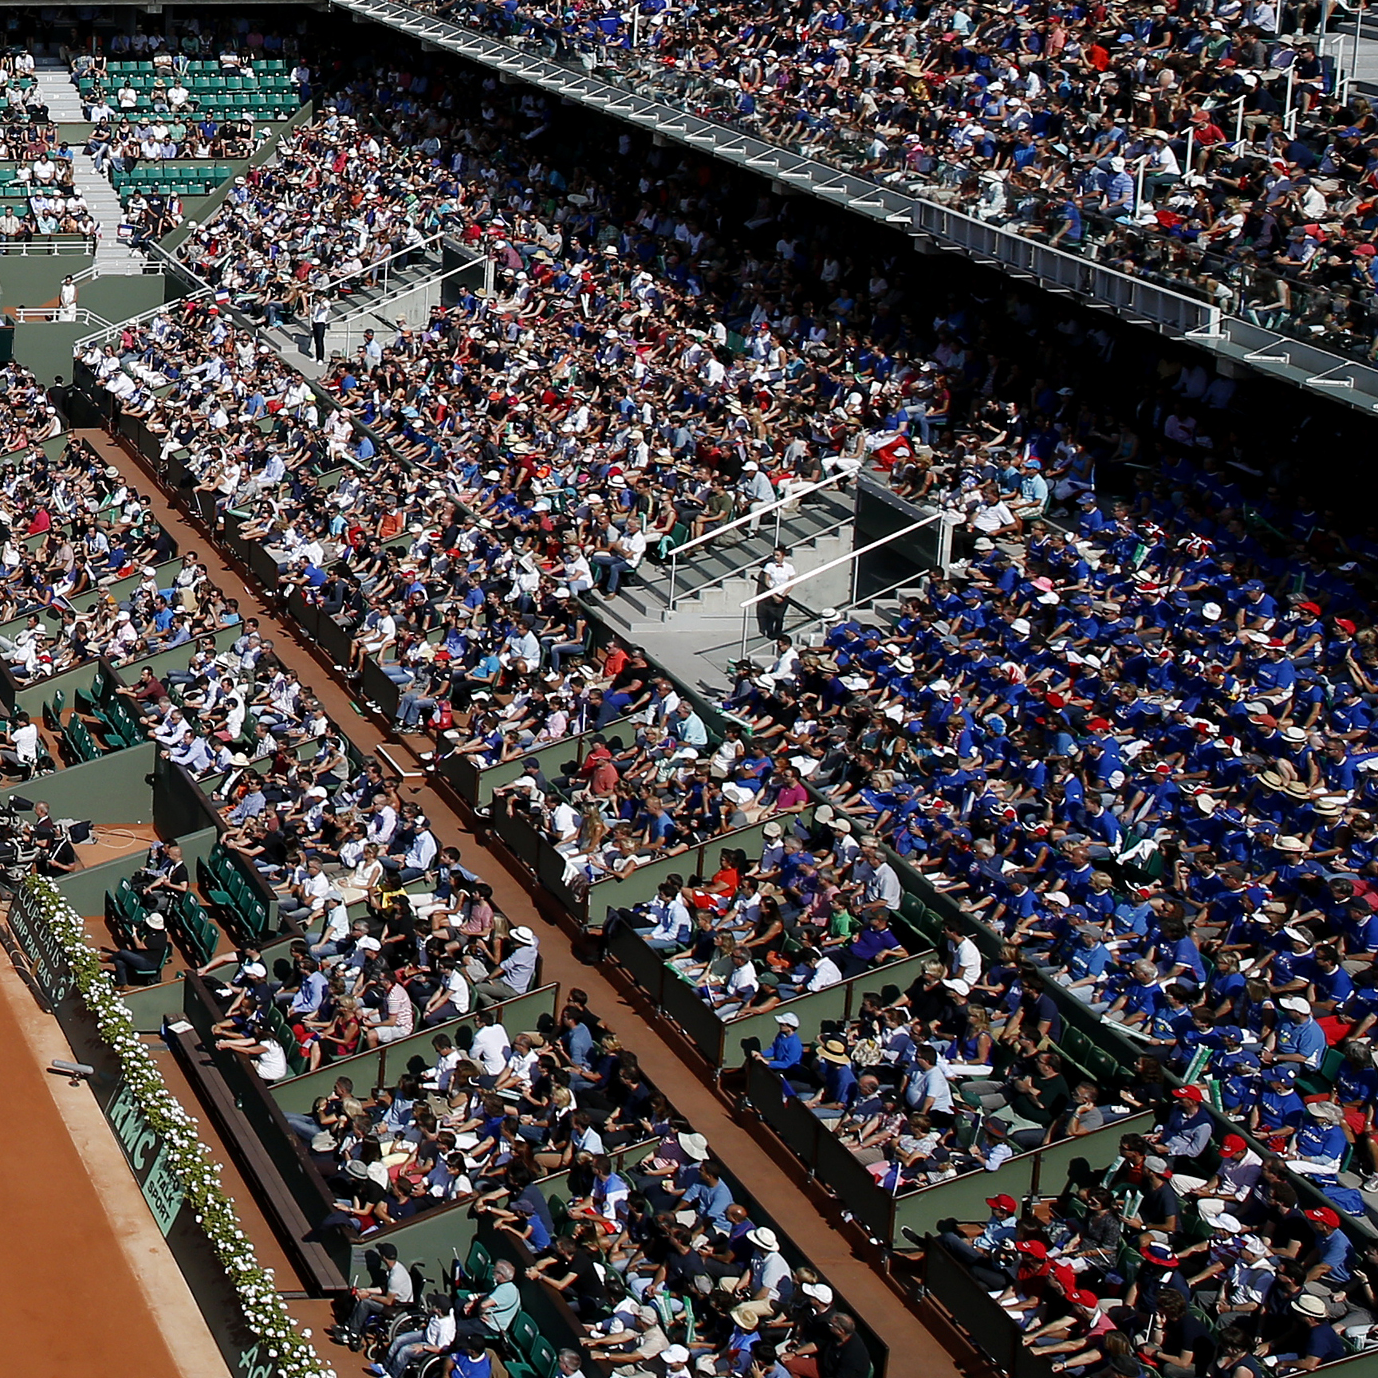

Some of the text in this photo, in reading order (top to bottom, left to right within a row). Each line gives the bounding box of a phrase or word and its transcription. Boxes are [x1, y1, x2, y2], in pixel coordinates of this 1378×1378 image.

[13, 910, 53, 988] BNP PARBAS
[110, 1083, 157, 1170] RMC
[147, 1180, 171, 1224] SPORT
[156, 1171, 175, 1208] TALK
